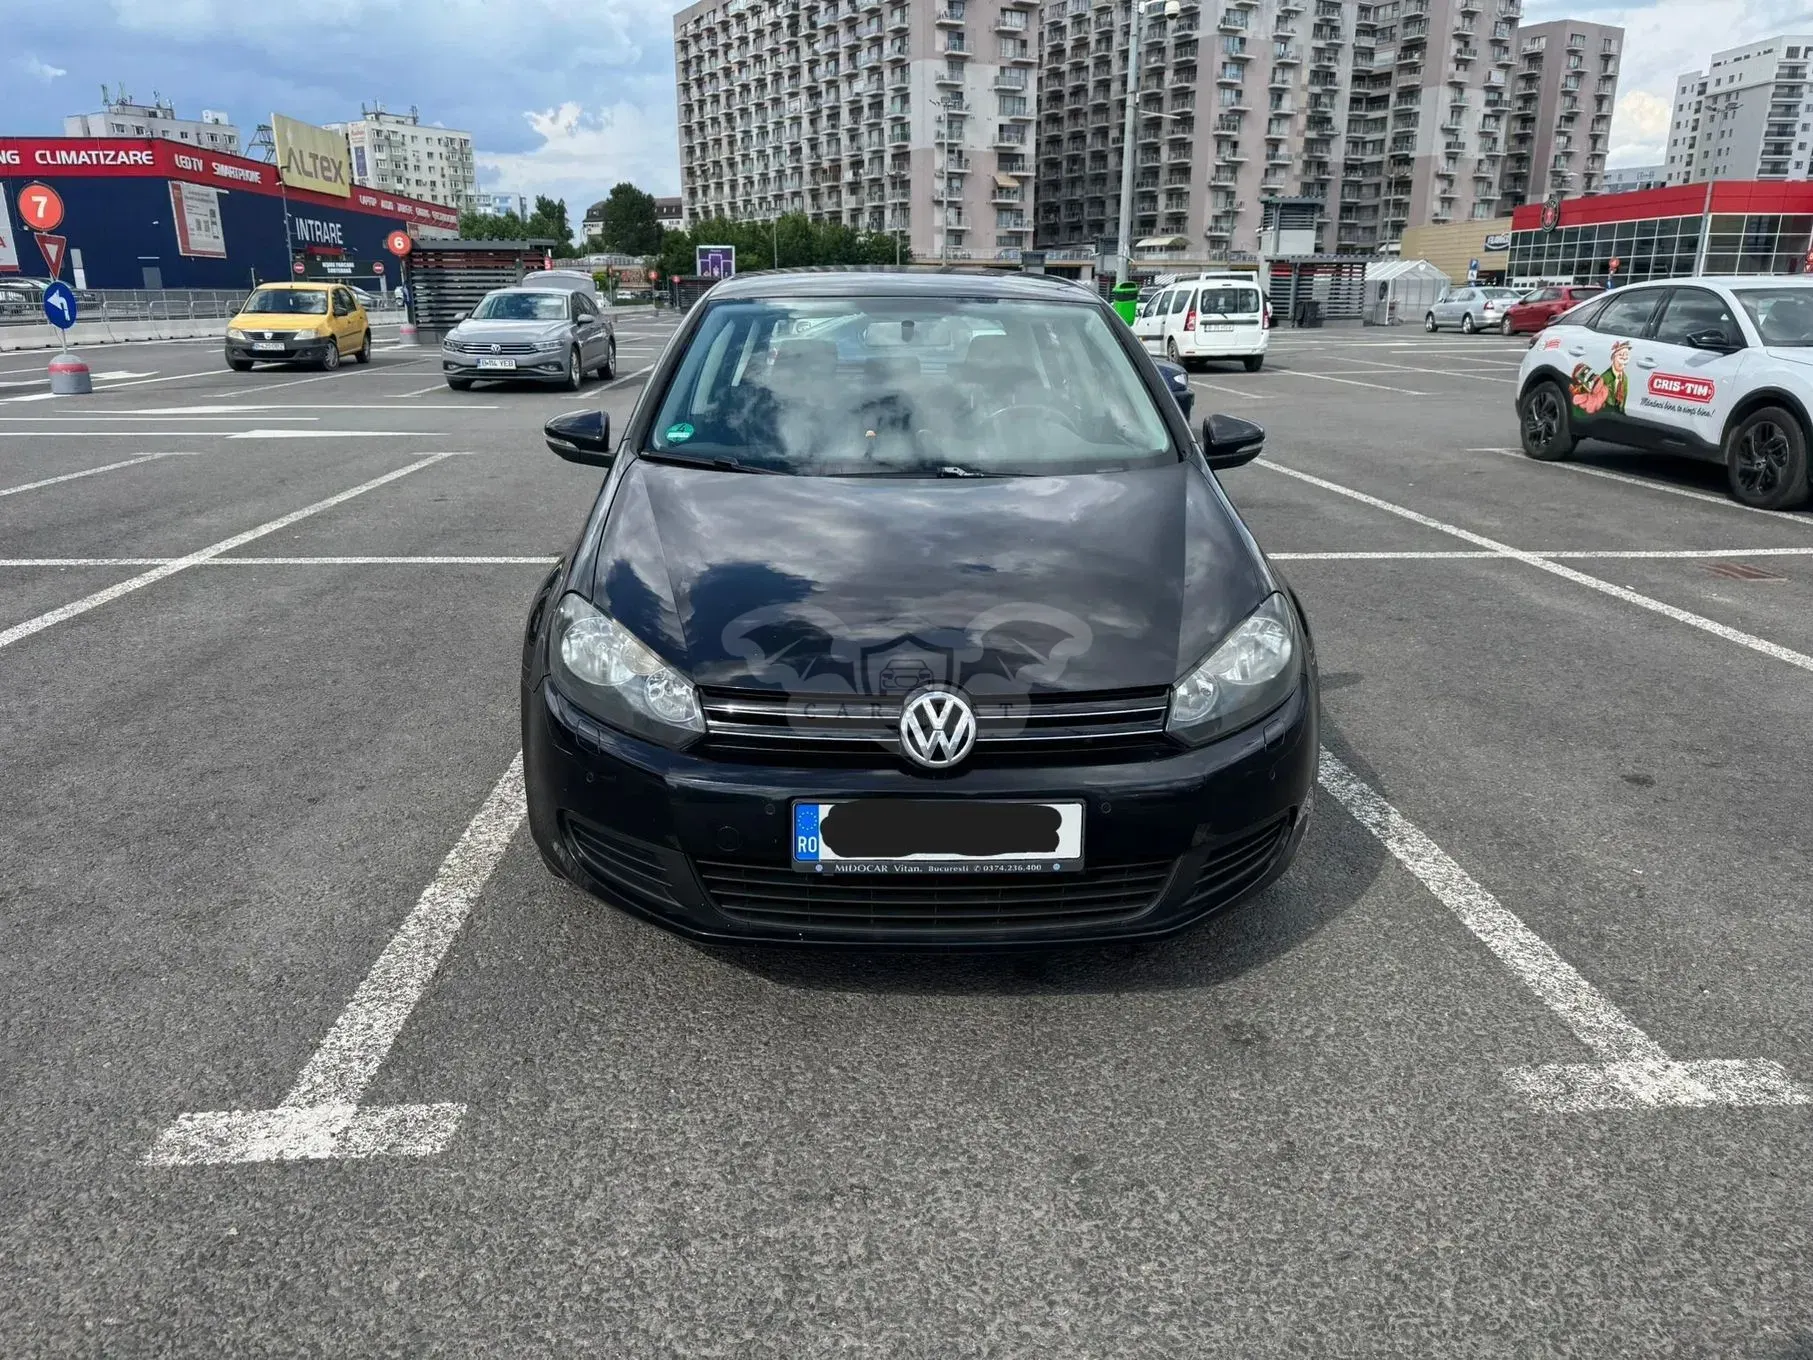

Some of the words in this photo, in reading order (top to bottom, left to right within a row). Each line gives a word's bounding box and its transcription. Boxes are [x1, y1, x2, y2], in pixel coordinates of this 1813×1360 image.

[35, 150, 154, 165] CLIMATIZARE
[31, 196, 48, 218] 7
[295, 217, 343, 245] INTRARE
[394, 237, 404, 249] 6
[798, 835, 818, 853] RO
[834, 864, 888, 873] MIDOCAR
